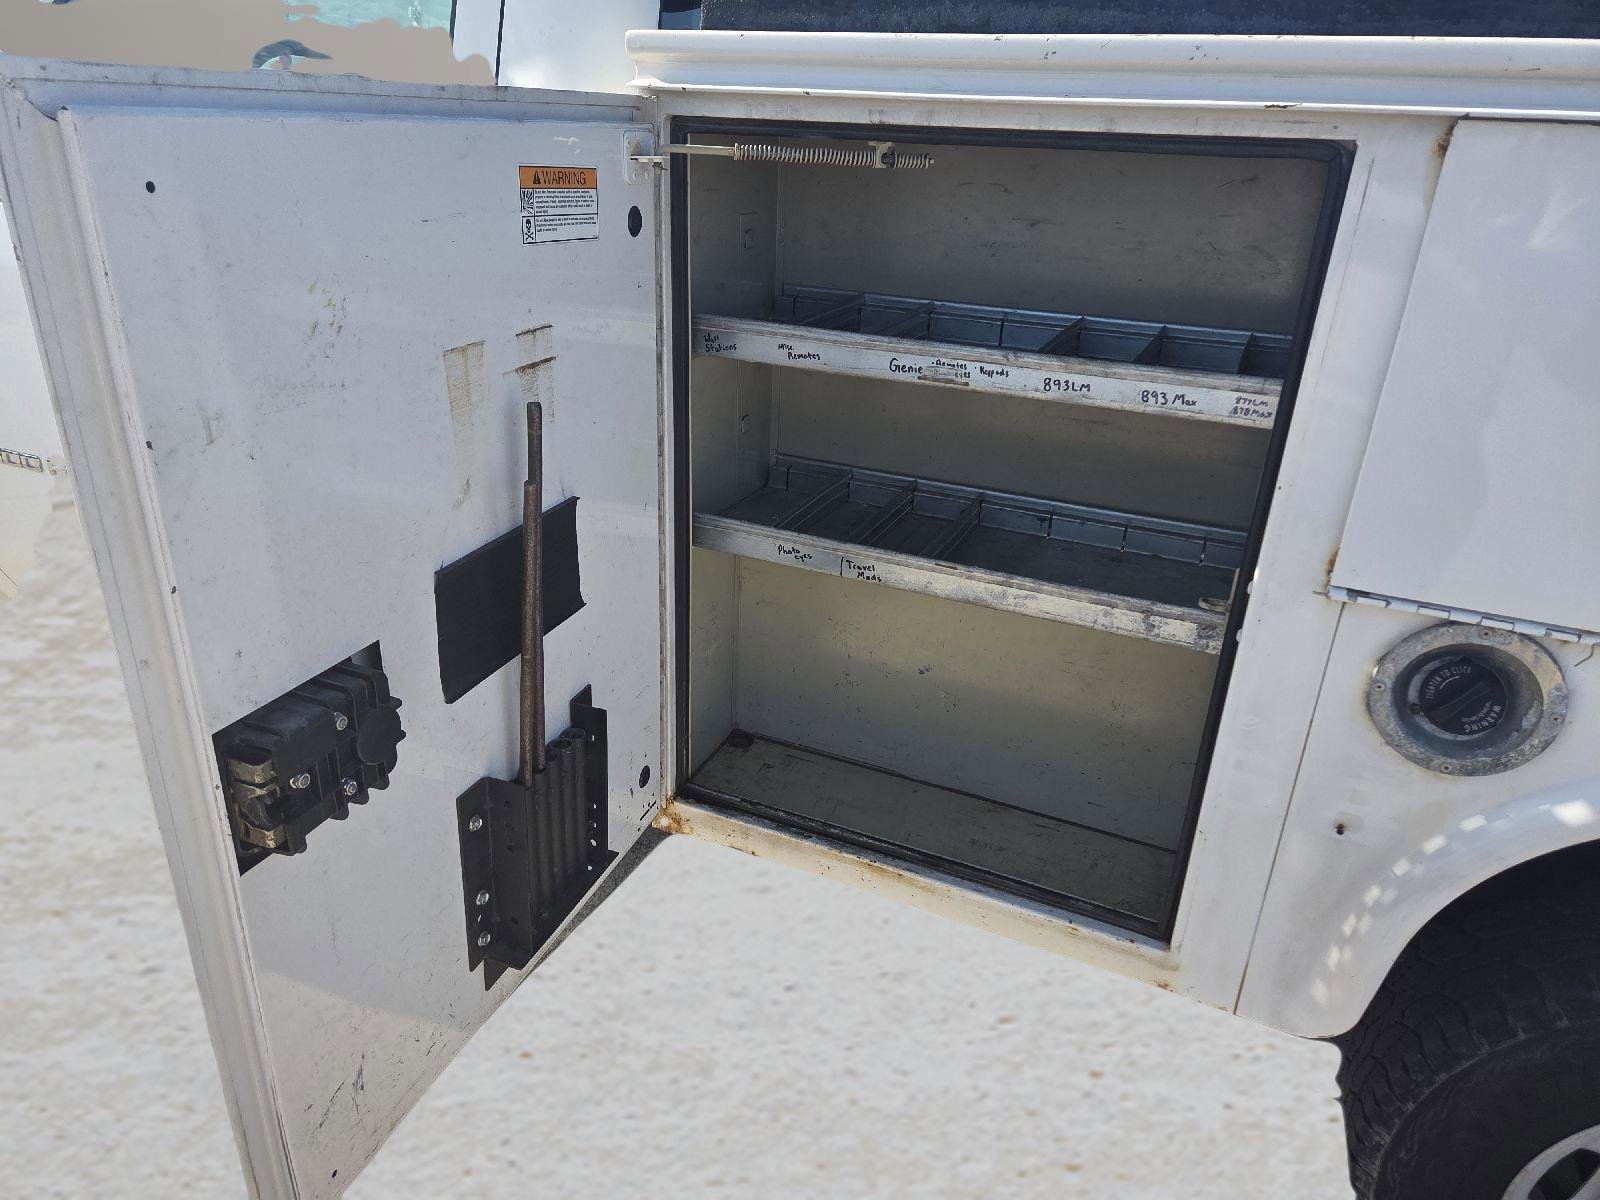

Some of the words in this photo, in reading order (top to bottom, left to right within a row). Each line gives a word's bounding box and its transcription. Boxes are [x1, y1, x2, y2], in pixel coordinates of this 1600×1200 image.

[542, 170, 587, 185] WARNING
[705, 343, 737, 352] Stations
[787, 352, 820, 360] Remotes
[889, 358, 924, 374] Genie
[1043, 377, 1091, 392] 893LM
[1141, 389, 1168, 405] 893
[1171, 393, 1198, 406] Max
[778, 544, 800, 555] Photo
[794, 553, 812, 562] eyes
[846, 560, 876, 572] Travel
[1464, 705, 1502, 732] WARNING
